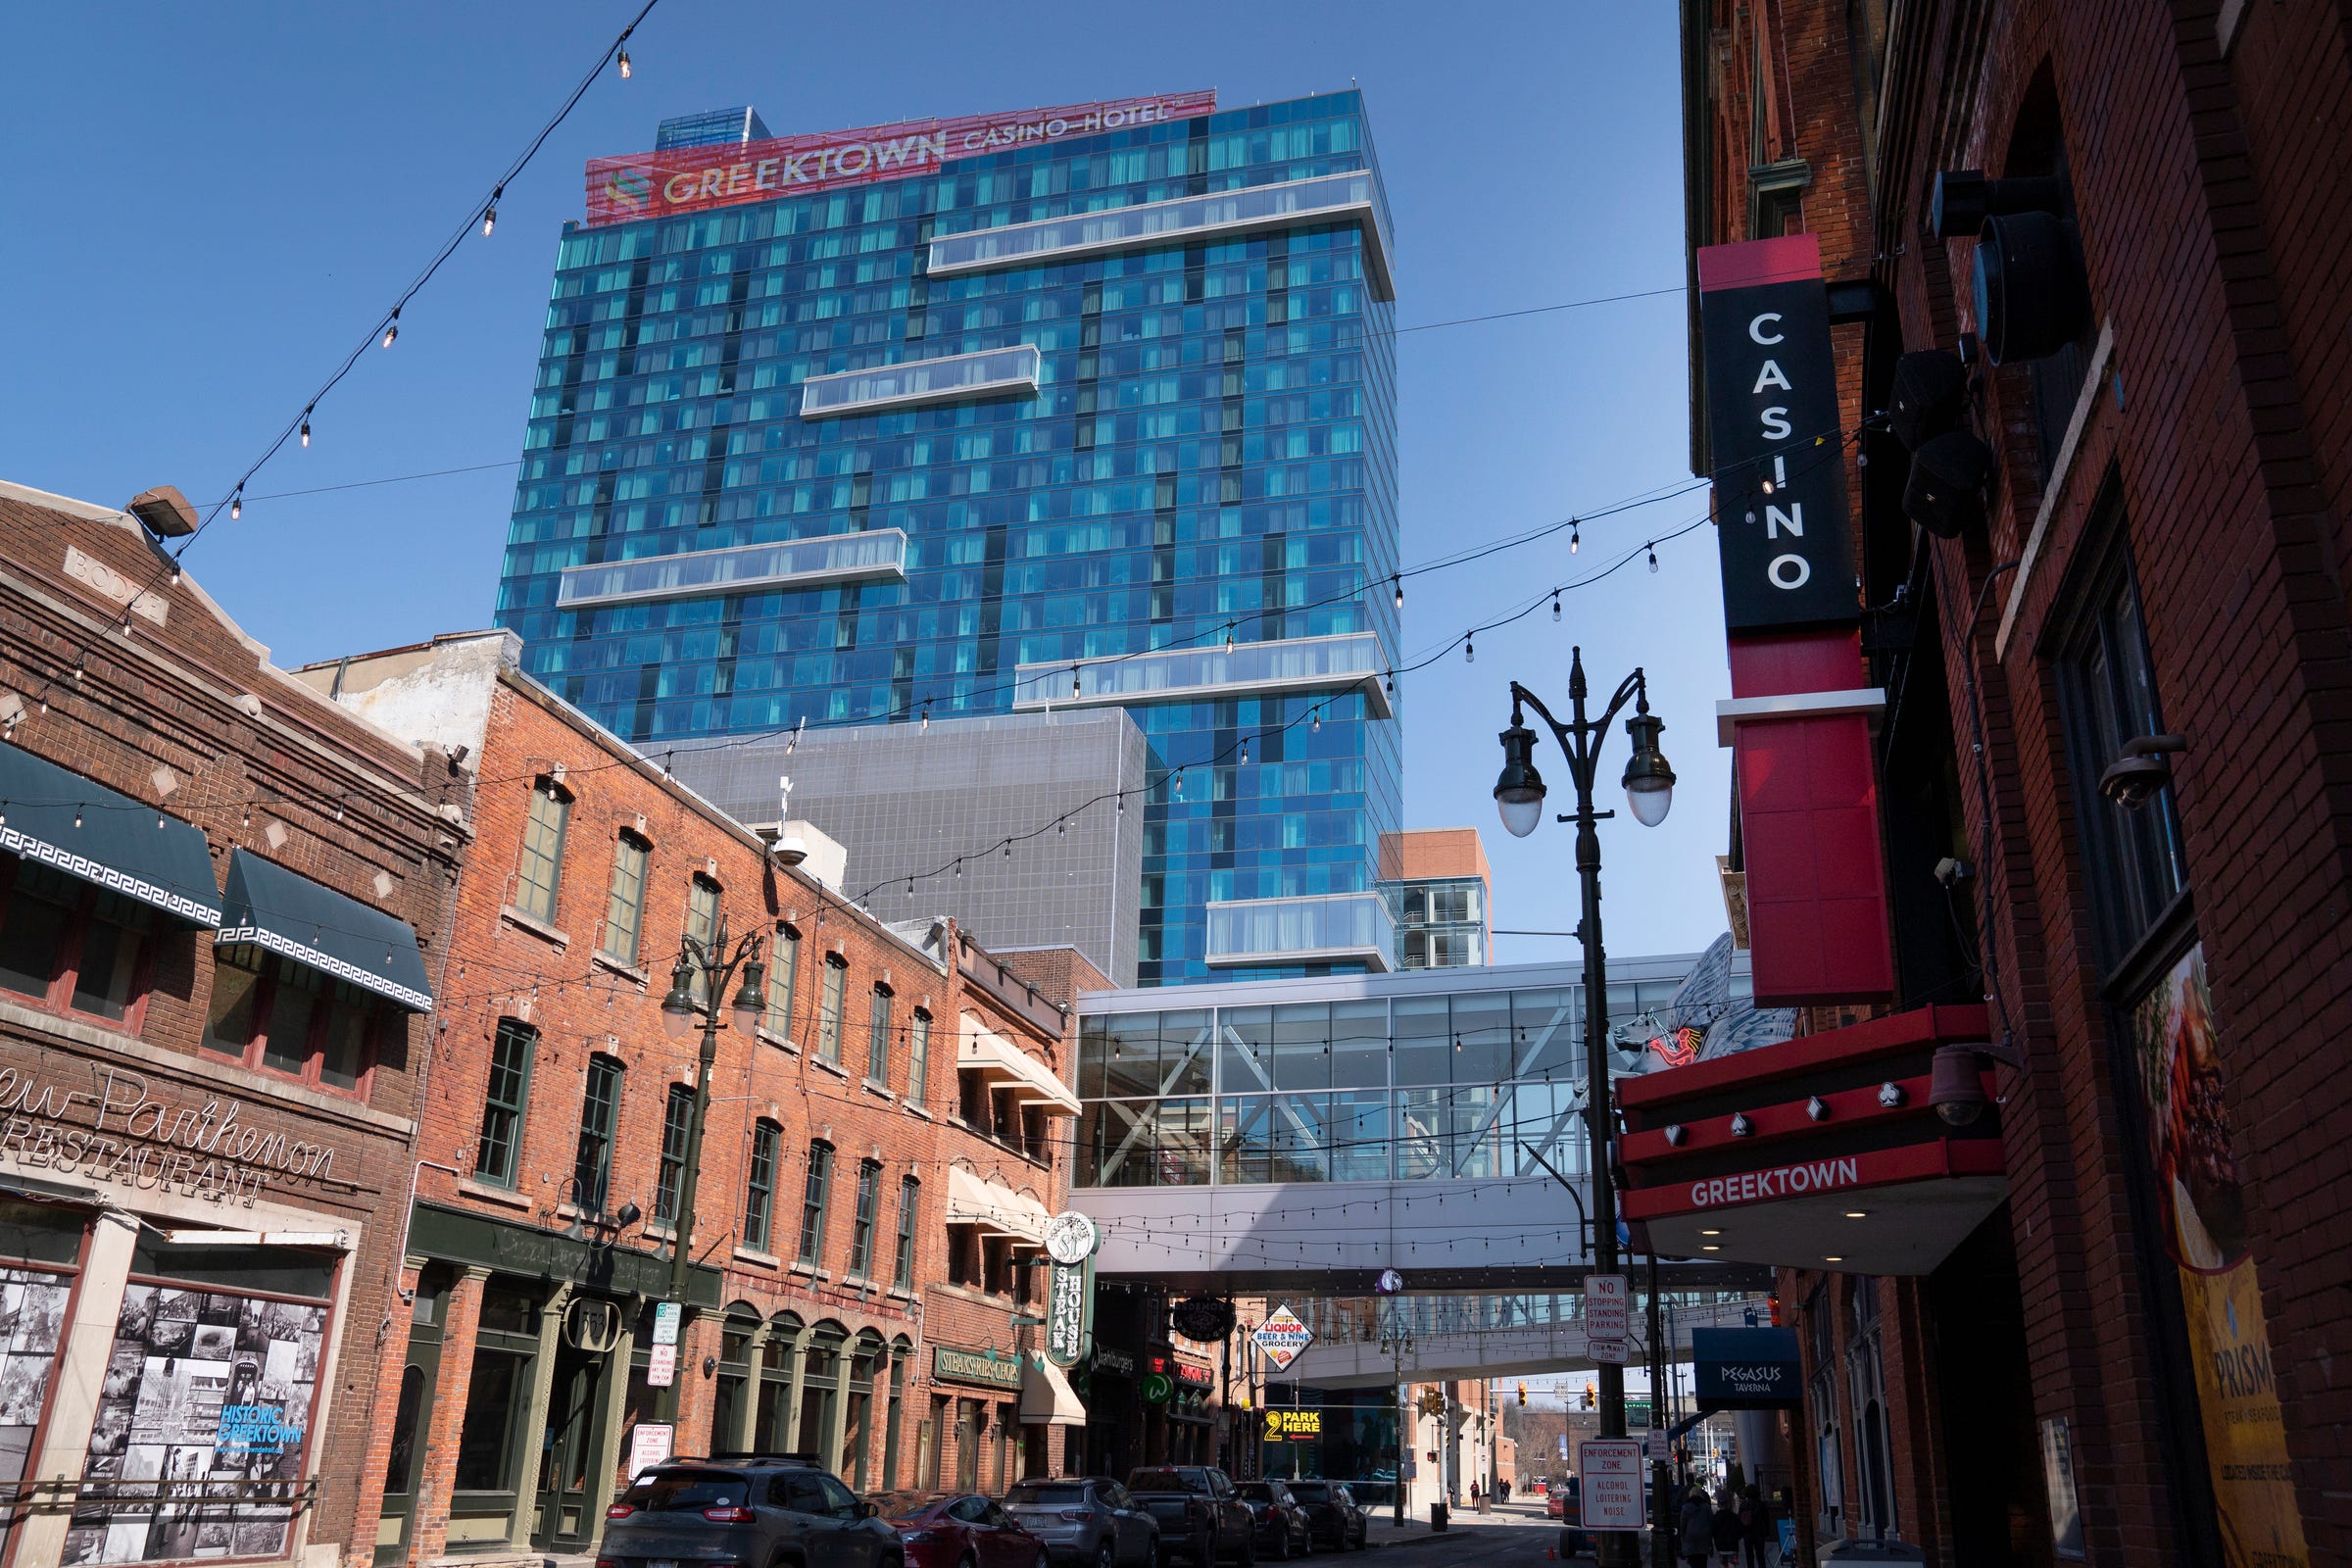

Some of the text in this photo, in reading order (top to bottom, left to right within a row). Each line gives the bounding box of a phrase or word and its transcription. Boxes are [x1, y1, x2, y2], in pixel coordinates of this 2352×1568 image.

[663, 130, 947, 204] GREEKTOWN
[1748, 312, 1811, 590] CASINO
[0, 1060, 362, 1187] ew Parthenon
[0, 1118, 270, 1208] RESTAURANT
[1691, 1157, 1858, 1206] GREEKTOWN
[1598, 1282, 1614, 1295] NO
[1052, 1266, 1068, 1349] STEAK
[1589, 1298, 1624, 1306] STOPPING
[1065, 1275, 1083, 1357] HOUSE
[1589, 1308, 1625, 1318] STANDING
[582, 1310, 606, 1340] 553
[1264, 1323, 1302, 1334] LIQUOR
[1590, 1320, 1624, 1330] PARKING
[942, 1351, 1019, 1383] STEAKS RIBS CHOPS
[1721, 1366, 1782, 1382] PEGASUS
[2215, 1341, 2275, 1399] PRISM
[1734, 1383, 1771, 1393] TAVERNA
[220, 1404, 284, 1425] HISTORIC
[1283, 1411, 1320, 1422] PARK
[217, 1423, 304, 1444] GREEKTOWN
[1283, 1422, 1320, 1433] HERE
[1602, 1460, 1622, 1469] ZONE
[1596, 1481, 1629, 1491] ALCOHOL
[1595, 1494, 1632, 1503] LOITERING
[1603, 1506, 1625, 1516] NOISE
